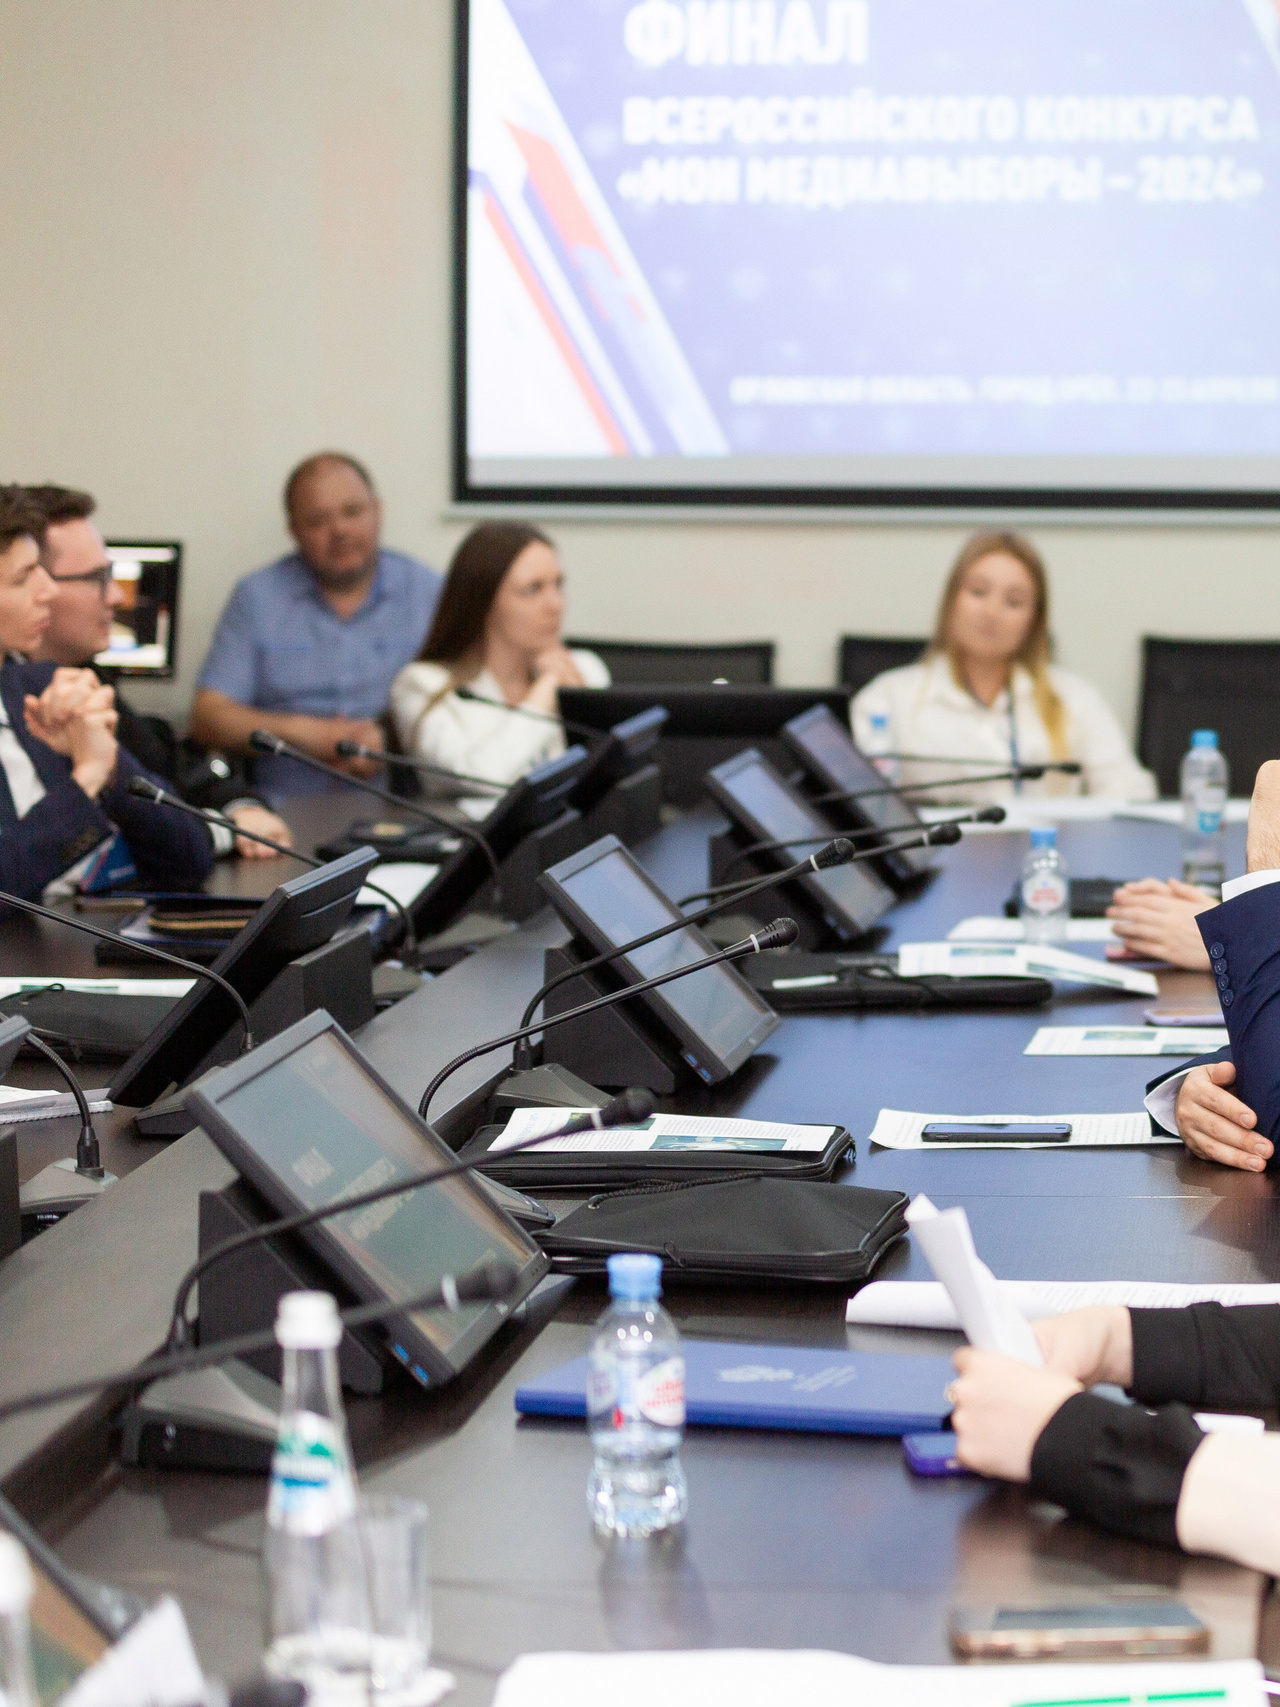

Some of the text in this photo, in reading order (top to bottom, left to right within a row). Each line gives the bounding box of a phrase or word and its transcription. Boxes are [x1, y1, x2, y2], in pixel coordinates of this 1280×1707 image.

[623, 0, 869, 67] ФИНАЛ
[623, 87, 1260, 144] ВСЕРОССИЙСКОГО КОНКУРСА
[746, 156, 1103, 208] МЕДИАВЫБОРЫ
